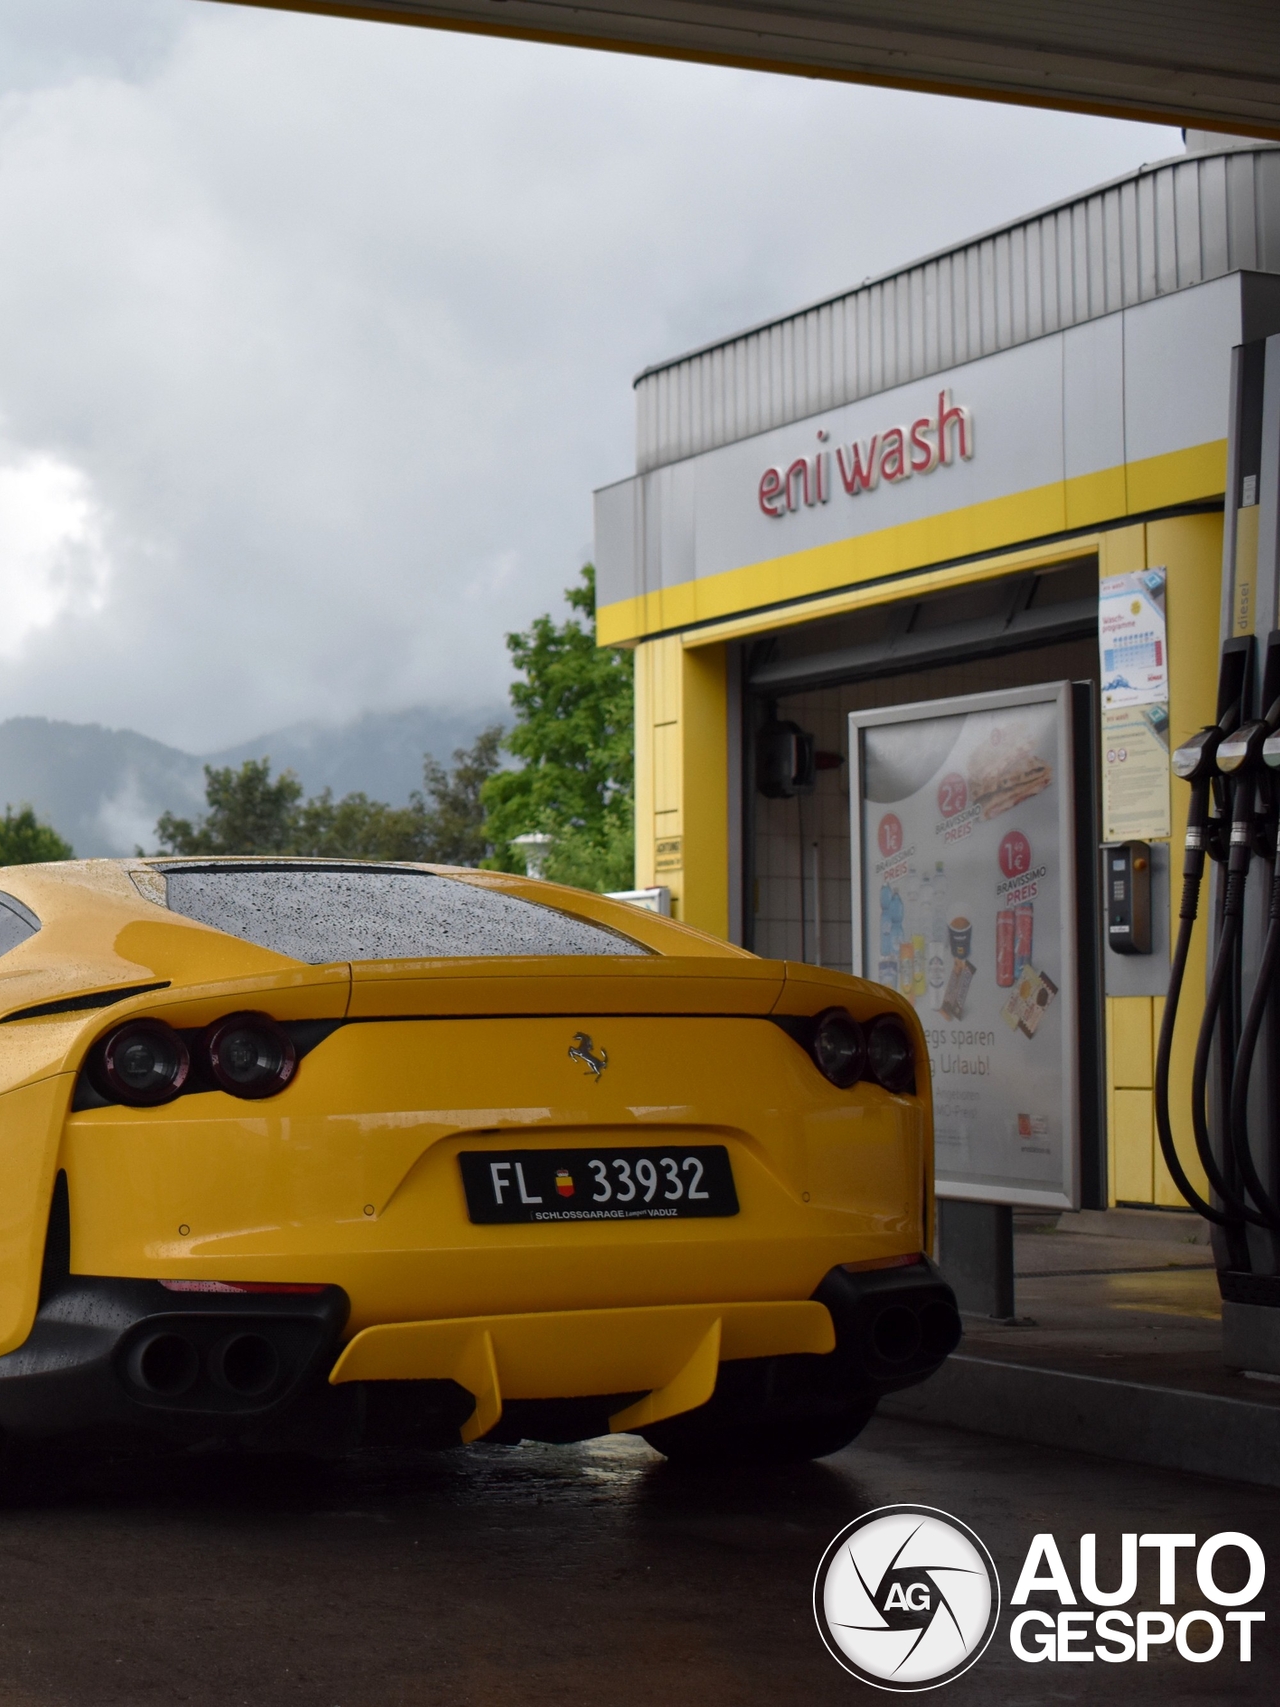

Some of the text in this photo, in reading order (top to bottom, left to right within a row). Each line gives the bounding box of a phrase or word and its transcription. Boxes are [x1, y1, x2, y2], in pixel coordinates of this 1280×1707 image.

[758, 388, 974, 518] eni wash
[1237, 582, 1249, 629] diesel
[935, 804, 981, 835] BRAVISSIMO
[944, 821, 972, 844] PREIS
[883, 861, 908, 882] PREIS
[996, 866, 1047, 895] BRAVISSIMO
[1006, 882, 1038, 906] PREIS
[950, 1030, 995, 1049] sparen
[940, 1053, 990, 1076] Urlaub!
[490, 1156, 710, 1205] FL 33932
[535, 1209, 624, 1220] SCHLOSSGARAGE
[647, 1208, 678, 1217] VADUZ
